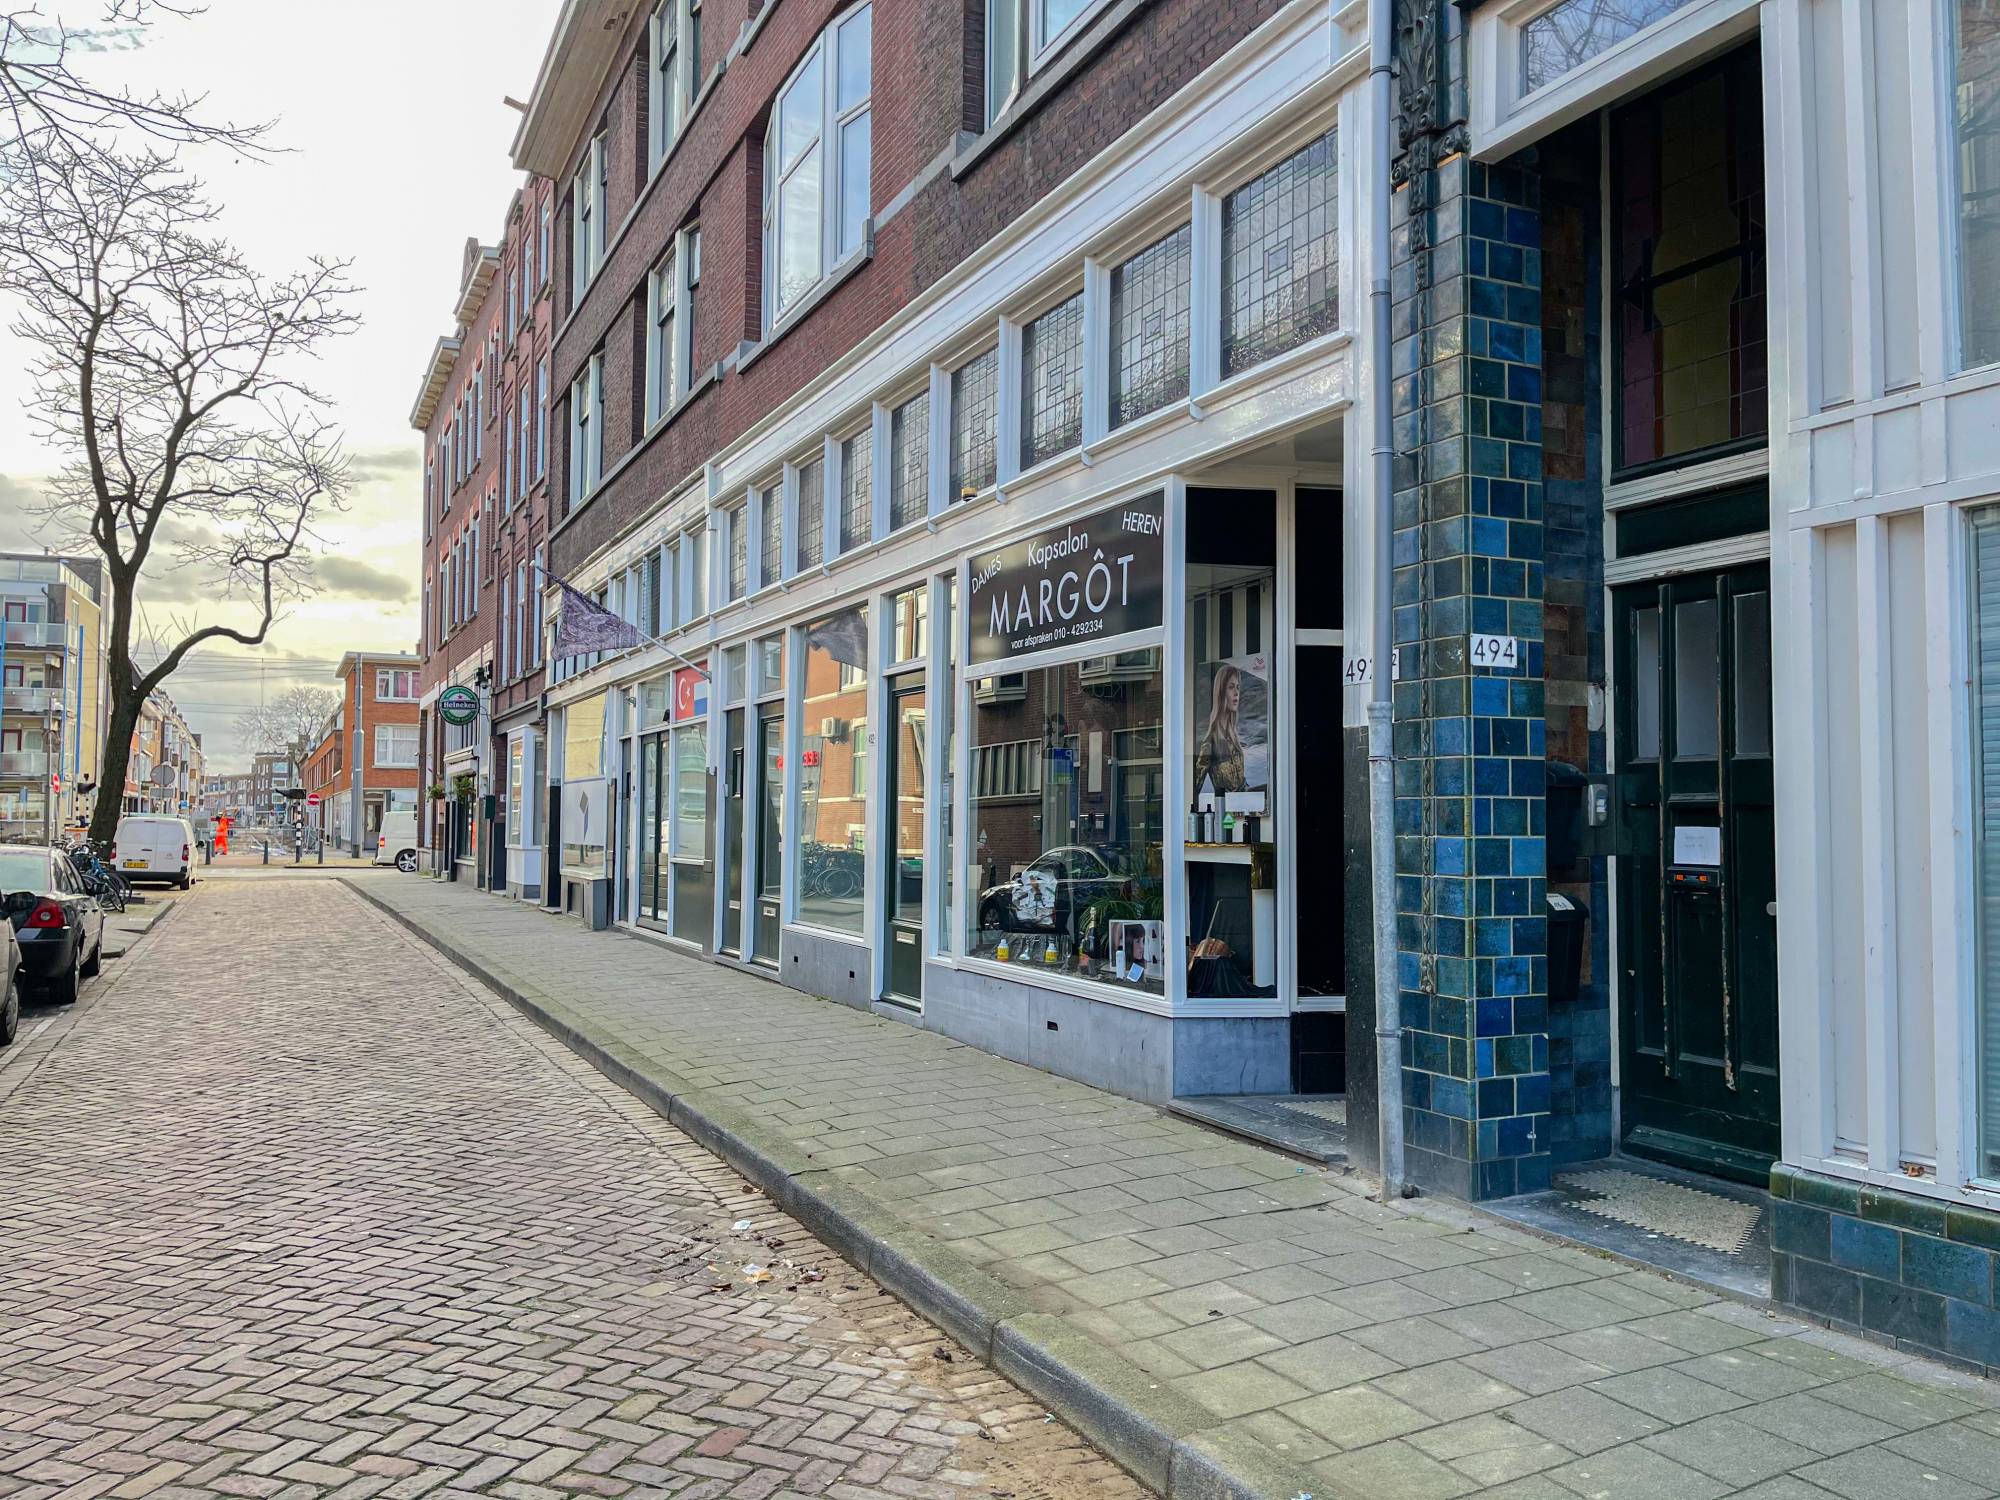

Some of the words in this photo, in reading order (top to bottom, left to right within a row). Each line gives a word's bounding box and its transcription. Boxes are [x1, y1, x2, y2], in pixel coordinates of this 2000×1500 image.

[1122, 511, 1162, 536] HEREN
[1028, 526, 1088, 570] Kapsalon
[972, 554, 1002, 594] DAMES
[989, 548, 1134, 638] MARGÔT
[1011, 639, 1025, 650] voor
[1024, 632, 1053, 649] afspraken
[1053, 627, 1066, 641] 010
[1070, 618, 1103, 637] 4292334
[1474, 637, 1515, 664] 494
[443, 701, 476, 709] Heineken
